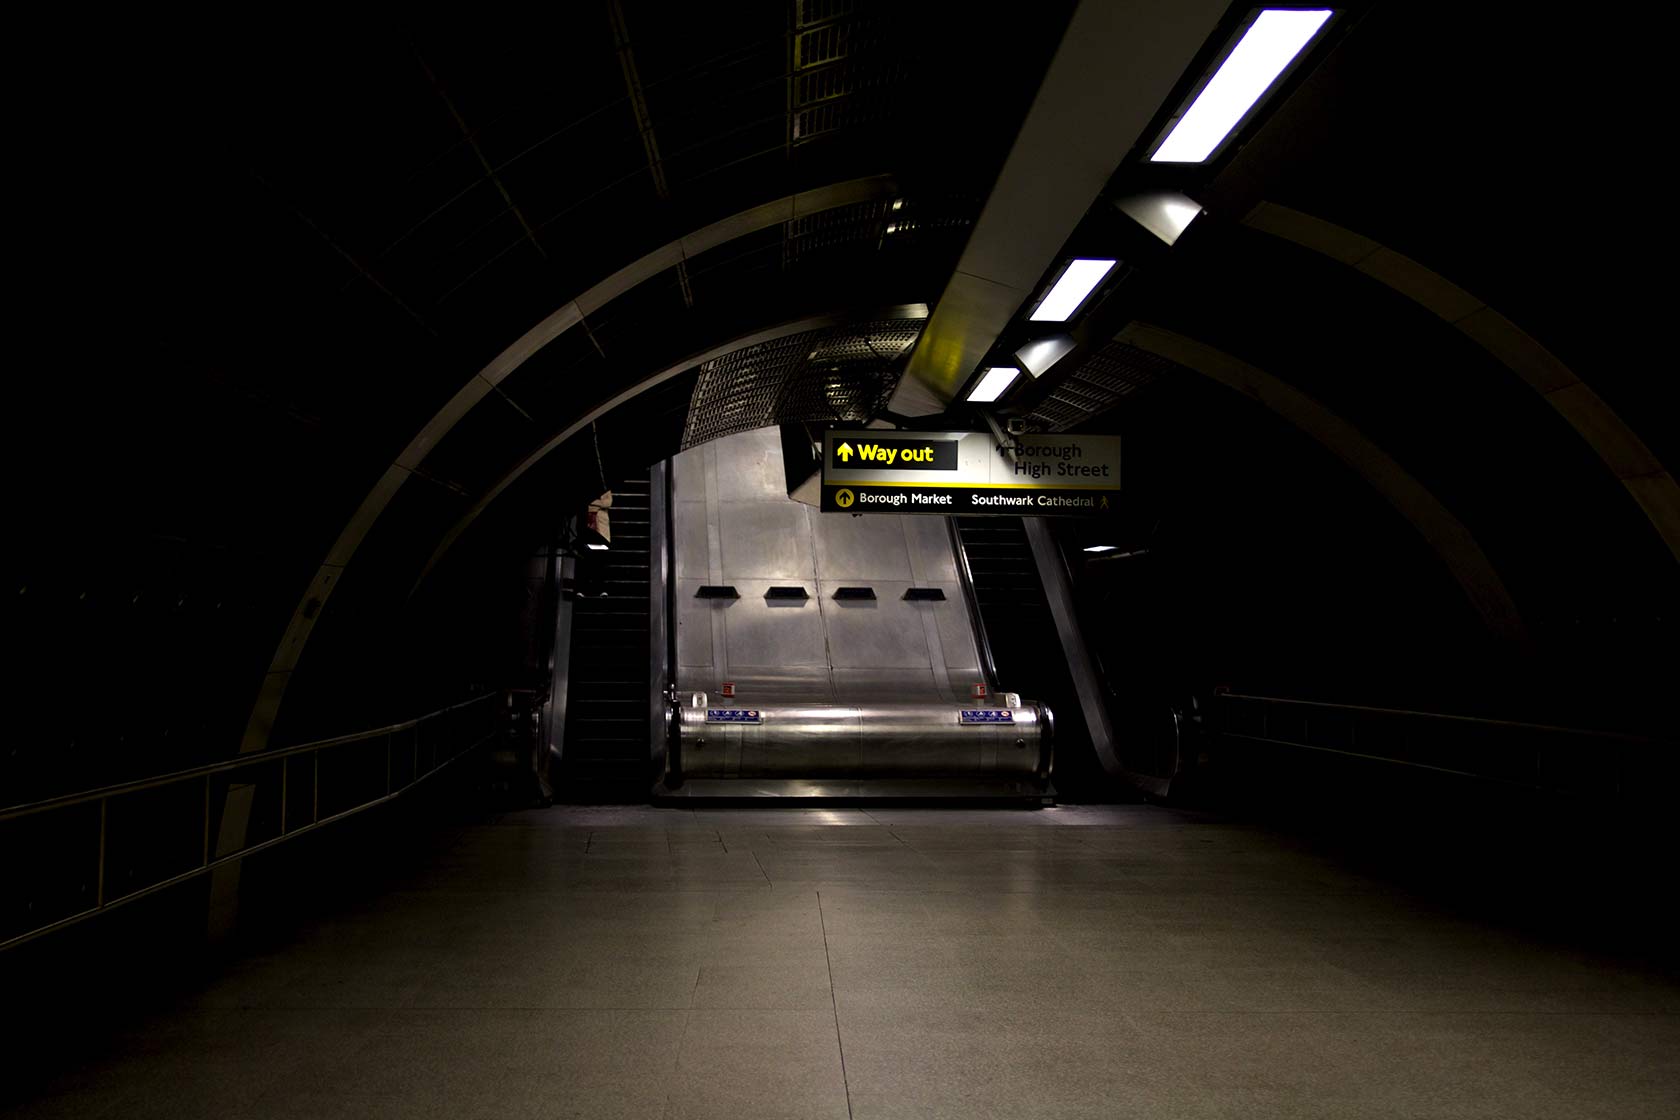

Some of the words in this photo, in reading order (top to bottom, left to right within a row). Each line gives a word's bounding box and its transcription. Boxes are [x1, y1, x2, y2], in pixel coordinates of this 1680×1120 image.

[857, 444, 897, 465] Way
[901, 446, 934, 462] out
[1015, 443, 1082, 461] Borough
[1015, 462, 1051, 479] High
[1057, 462, 1109, 477] Street
[860, 493, 908, 506] Borough
[911, 494, 952, 505] Market
[972, 494, 1034, 506] Southwark
[1037, 495, 1094, 507] Cathedral
